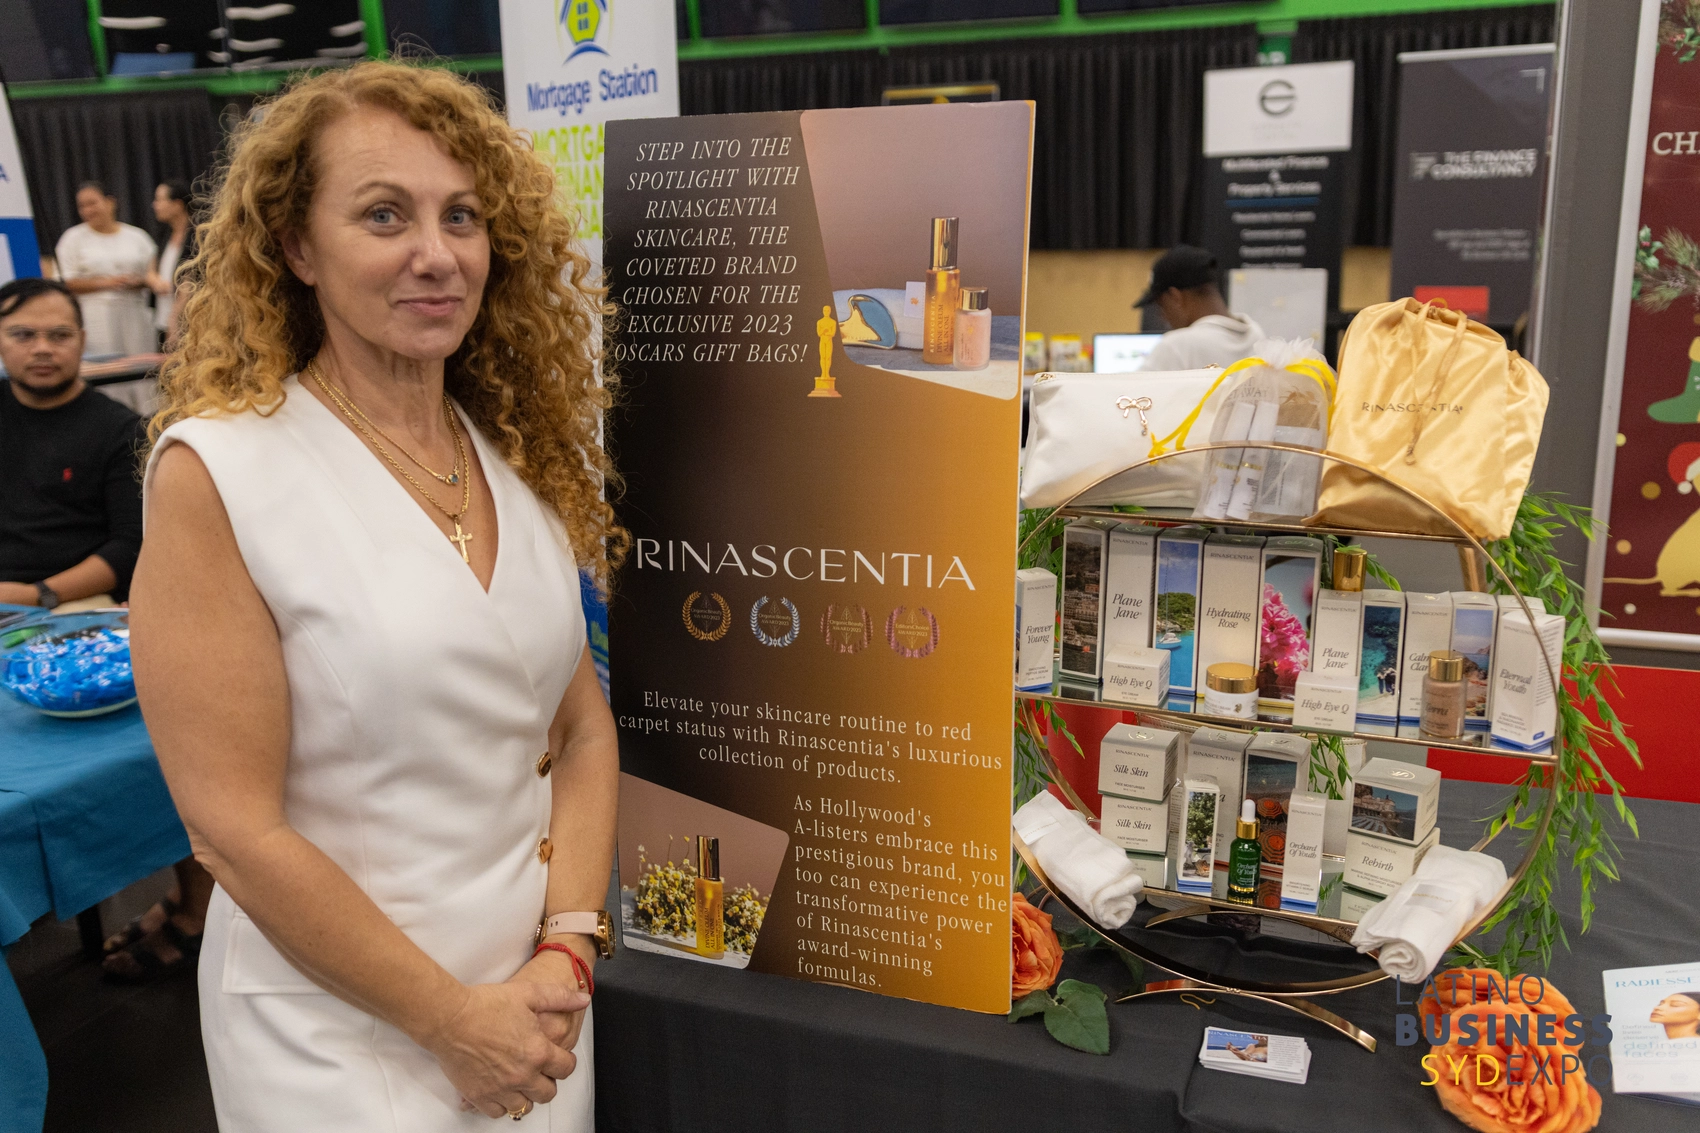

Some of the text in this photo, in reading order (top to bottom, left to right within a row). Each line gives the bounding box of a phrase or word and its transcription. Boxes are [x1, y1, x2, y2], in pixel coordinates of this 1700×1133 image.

[527, 64, 658, 116] Mortgage Station
[636, 137, 792, 162] STEP INTO THE
[1652, 131, 1700, 155] CH
[627, 168, 739, 191] SPOTLIGHT
[747, 166, 800, 187] WITH
[645, 197, 777, 219] RINASCENTIA
[634, 226, 790, 249] SKINCARE, THE
[626, 255, 797, 277] COVETED BRAND
[623, 285, 800, 305] CHOSEN FOR THE
[627, 314, 792, 335] EXCLUSIVE 2023
[615, 343, 807, 363] OSCARS GIFT BAGS!
[637, 538, 976, 591] RINASCENTIA
[1112, 593, 1143, 607] Plane
[1113, 607, 1140, 619] Jane
[1206, 607, 1251, 622] Hydrating
[1026, 625, 1053, 635] Forever
[1218, 619, 1238, 628] Rose
[1027, 635, 1050, 644] Young
[1322, 647, 1349, 659] Plane
[1323, 659, 1346, 669] Jane
[1410, 662, 1429, 671] Clar
[1109, 675, 1153, 690] High Eye Q
[1500, 668, 1533, 685] Eternal
[1503, 680, 1527, 695] Youth
[643, 690, 972, 741] Elevate your skincare routine to red
[1301, 699, 1349, 715] High Eye Q
[619, 713, 1002, 770] carpet status with Rinascentia's luxurious
[699, 745, 901, 784] collection of products.
[1193, 751, 1236, 762] RINASCENTIA
[1114, 764, 1149, 777] Silk Skin
[794, 795, 932, 828] As Hollywood's
[1116, 819, 1152, 830] Silk Skin
[794, 818, 998, 861] A-listers embrace this
[1289, 841, 1318, 852] Orchard
[1289, 849, 1317, 860] Of Youth
[1361, 856, 1394, 872] Rebirth
[795, 844, 1005, 888] prestigious brand, you
[796, 866, 1007, 913] too can experience the
[796, 890, 993, 934] transformative power
[797, 912, 942, 950] of Rinascentia's
[797, 938, 933, 977] award-winning
[797, 957, 882, 987] formulas.
[1624, 1040, 1698, 1051] defined
[1624, 1050, 1679, 1059] faces
